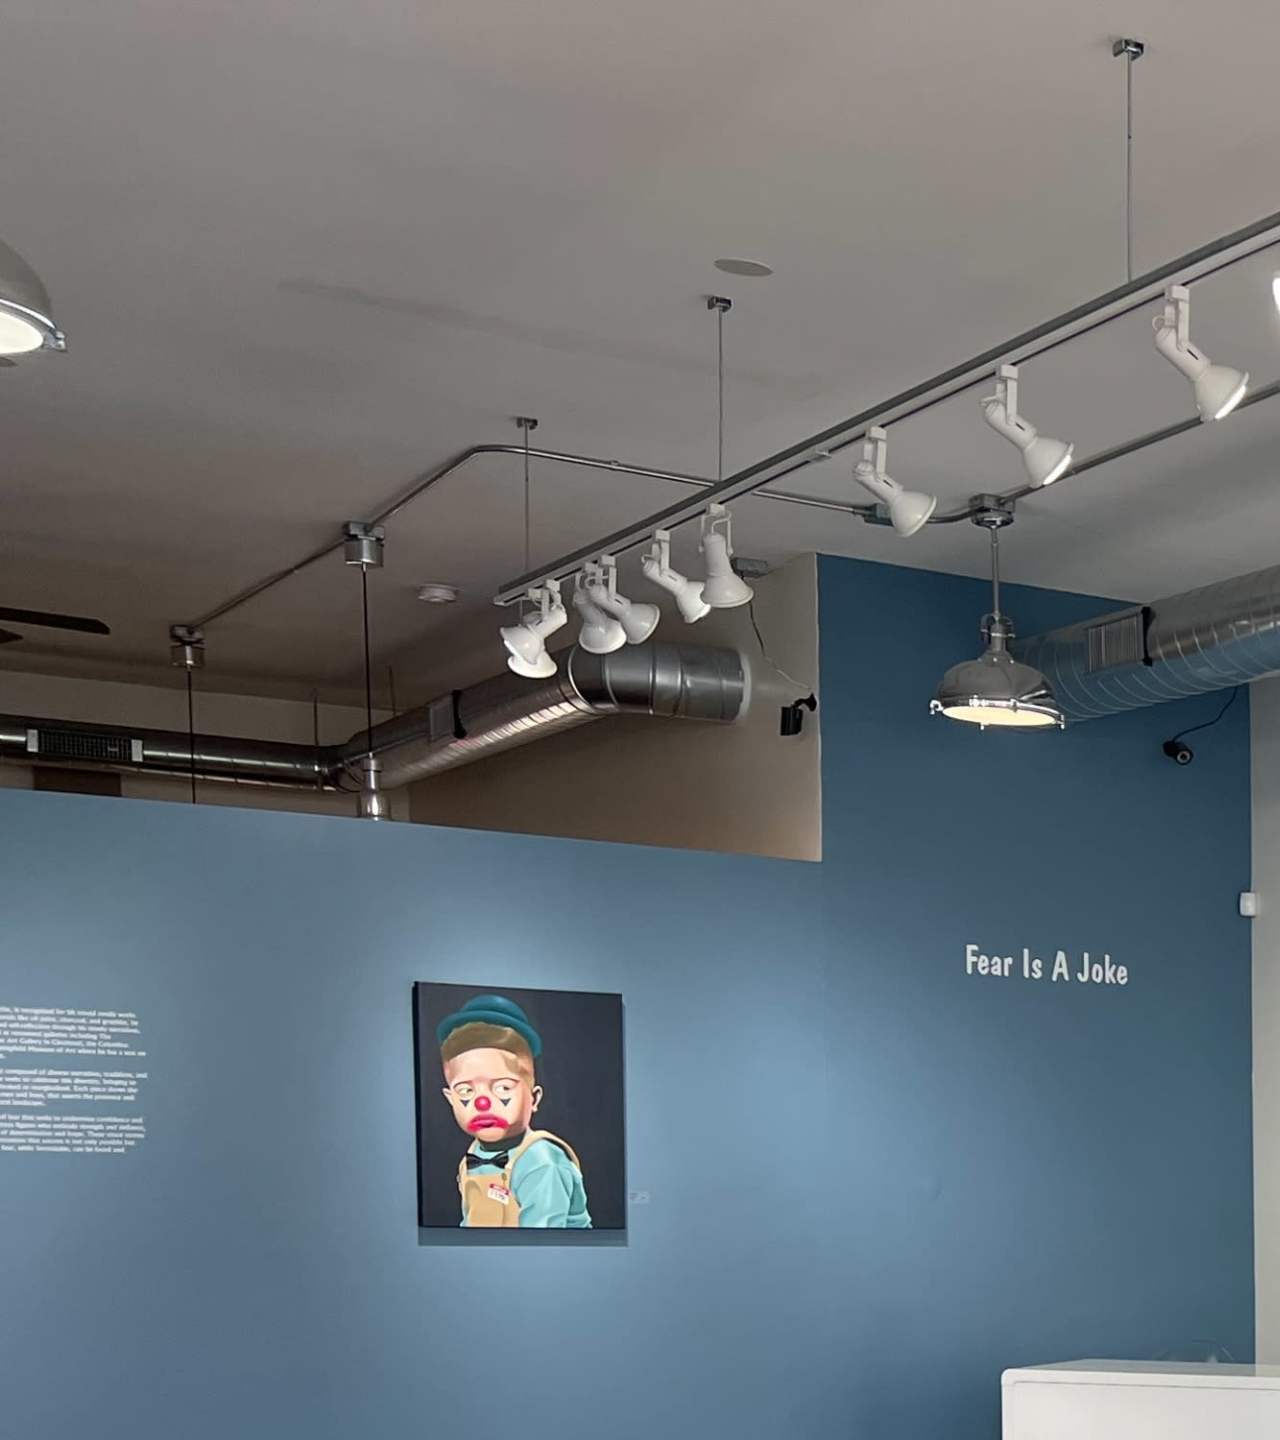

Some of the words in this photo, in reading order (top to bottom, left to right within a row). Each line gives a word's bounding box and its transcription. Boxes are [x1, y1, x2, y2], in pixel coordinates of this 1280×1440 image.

[966, 944, 1013, 977] Fear
[1023, 948, 1043, 979] Is
[1051, 950, 1070, 982] A
[1076, 952, 1128, 985] Joke
